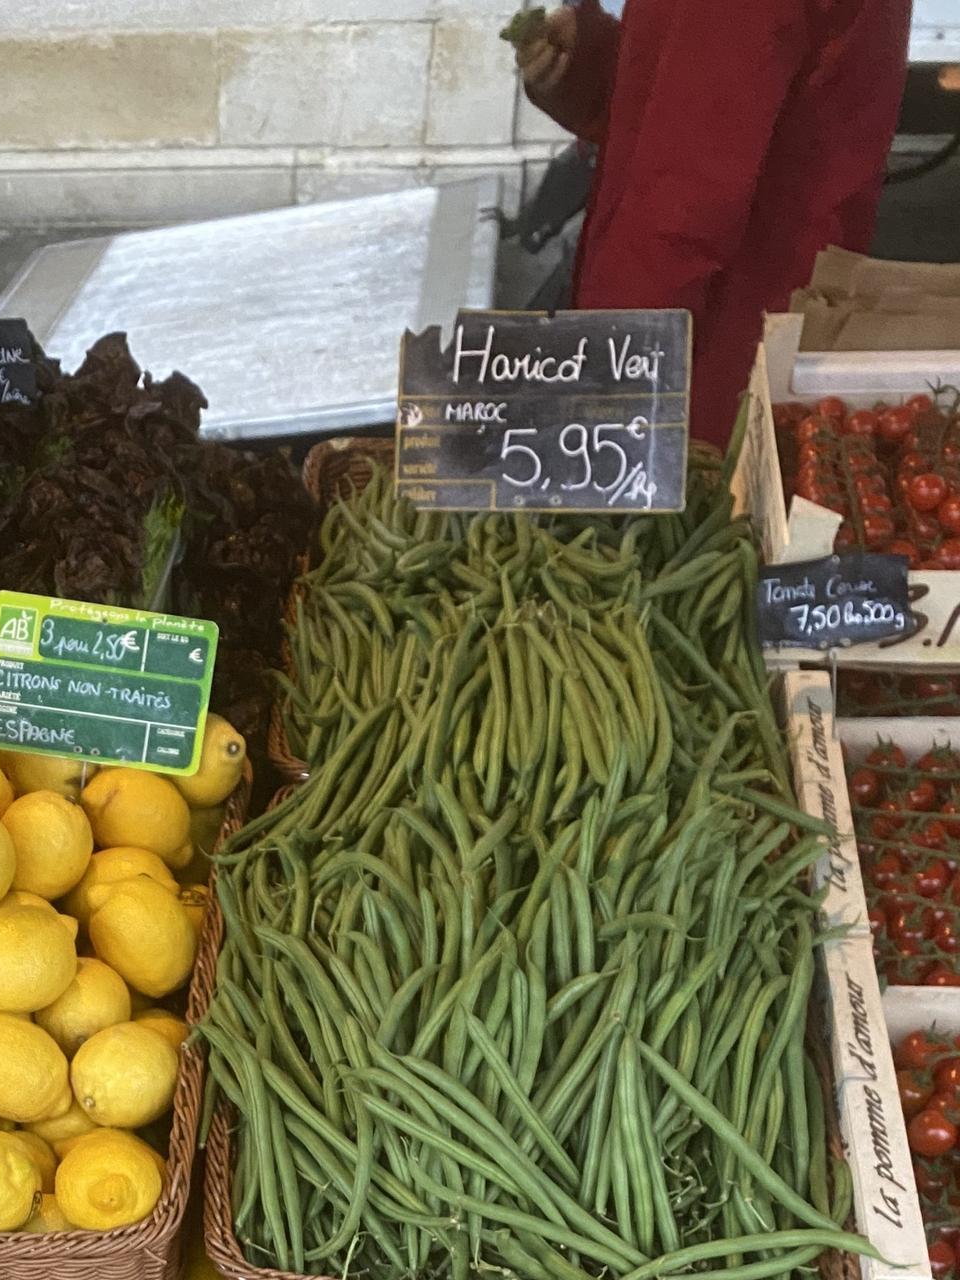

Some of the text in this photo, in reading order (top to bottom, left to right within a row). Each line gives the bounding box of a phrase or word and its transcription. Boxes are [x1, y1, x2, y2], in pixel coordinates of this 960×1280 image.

[453, 324, 665, 384] Haricot Vert
[444, 402, 508, 423] MAROC
[0, 617, 30, 641] AB
[41, 618, 55, 645] 3
[152, 615, 205, 631] planète
[188, 647, 204, 663] €
[845, 970, 908, 1229] la pomme d'amour
